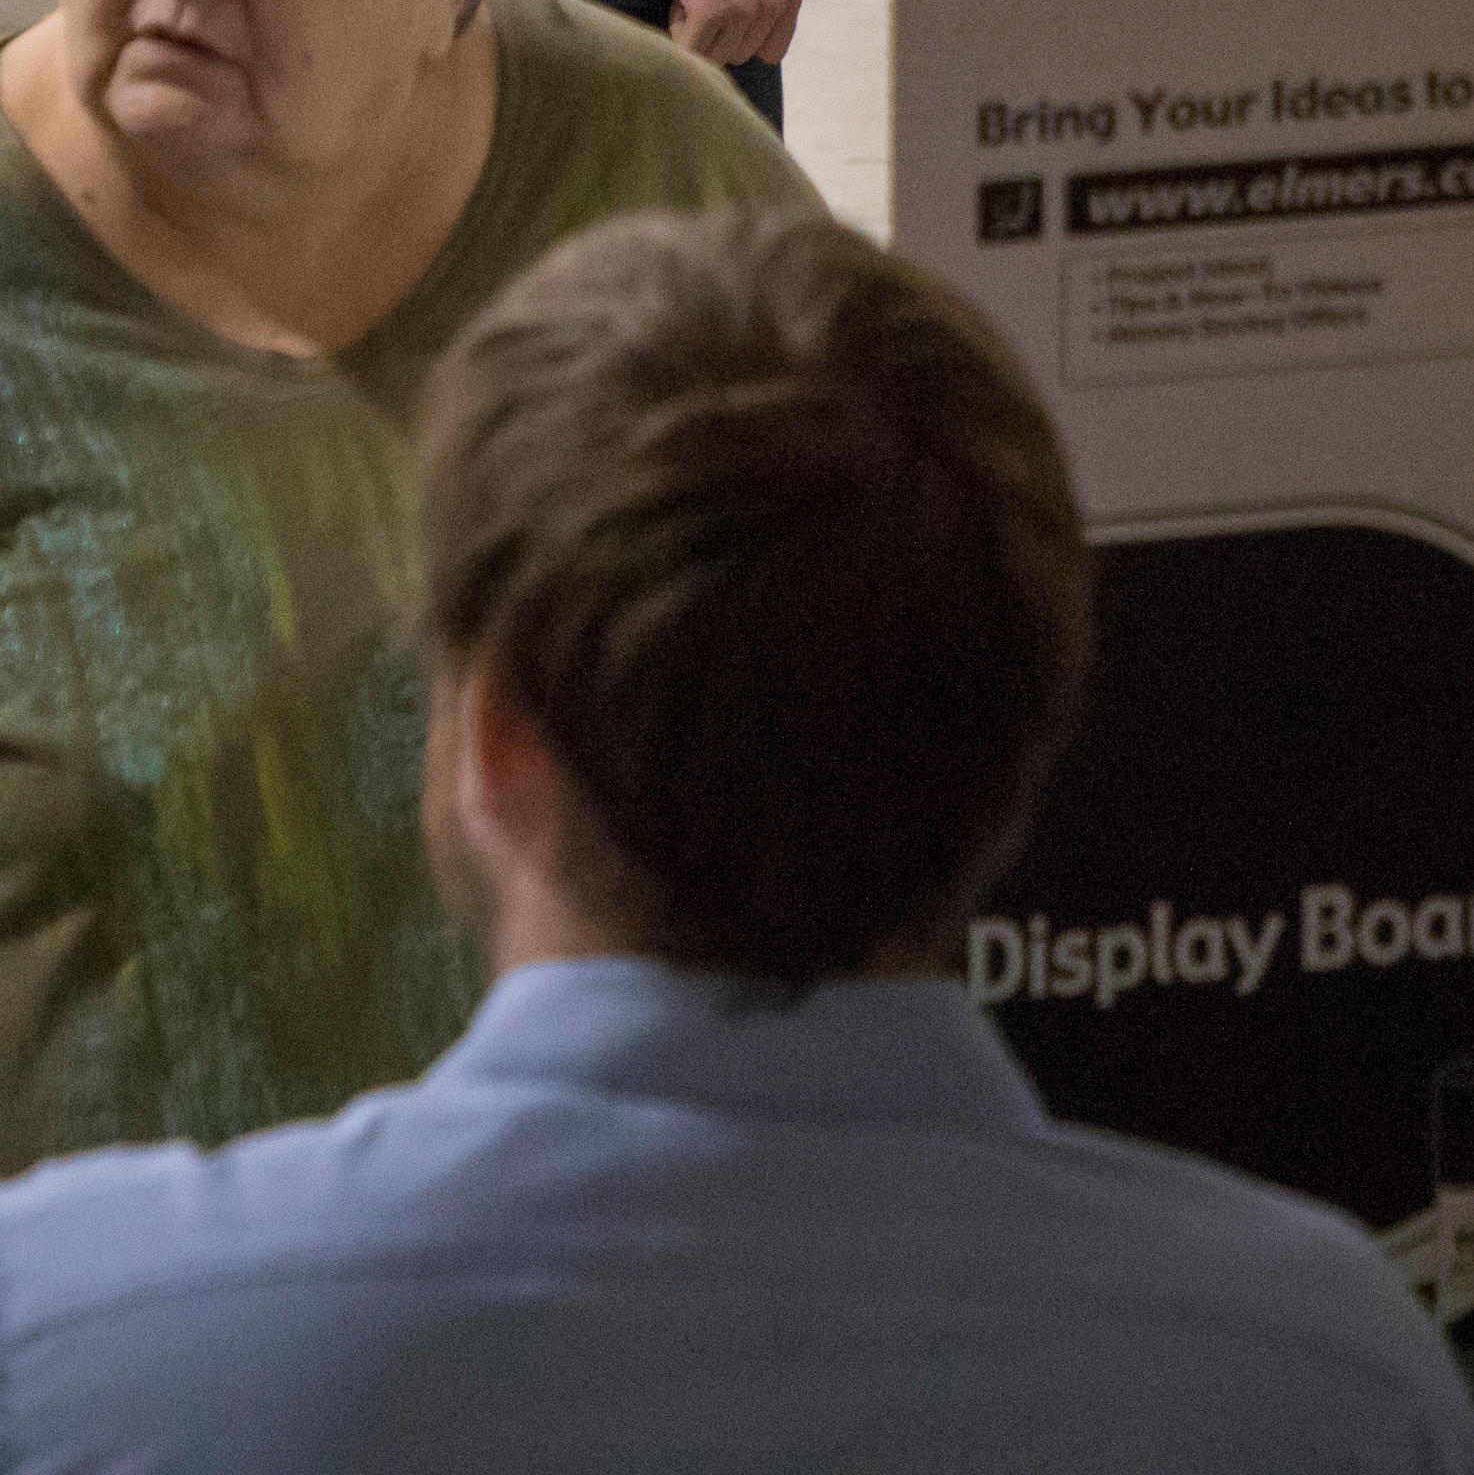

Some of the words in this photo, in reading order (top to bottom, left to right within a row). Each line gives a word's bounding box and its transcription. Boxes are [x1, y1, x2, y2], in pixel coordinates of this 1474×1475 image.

[976, 100, 1118, 149] Bring
[1125, 87, 1255, 133] Your
[1271, 73, 1411, 122] Ideas
[967, 900, 1285, 1009] Display
